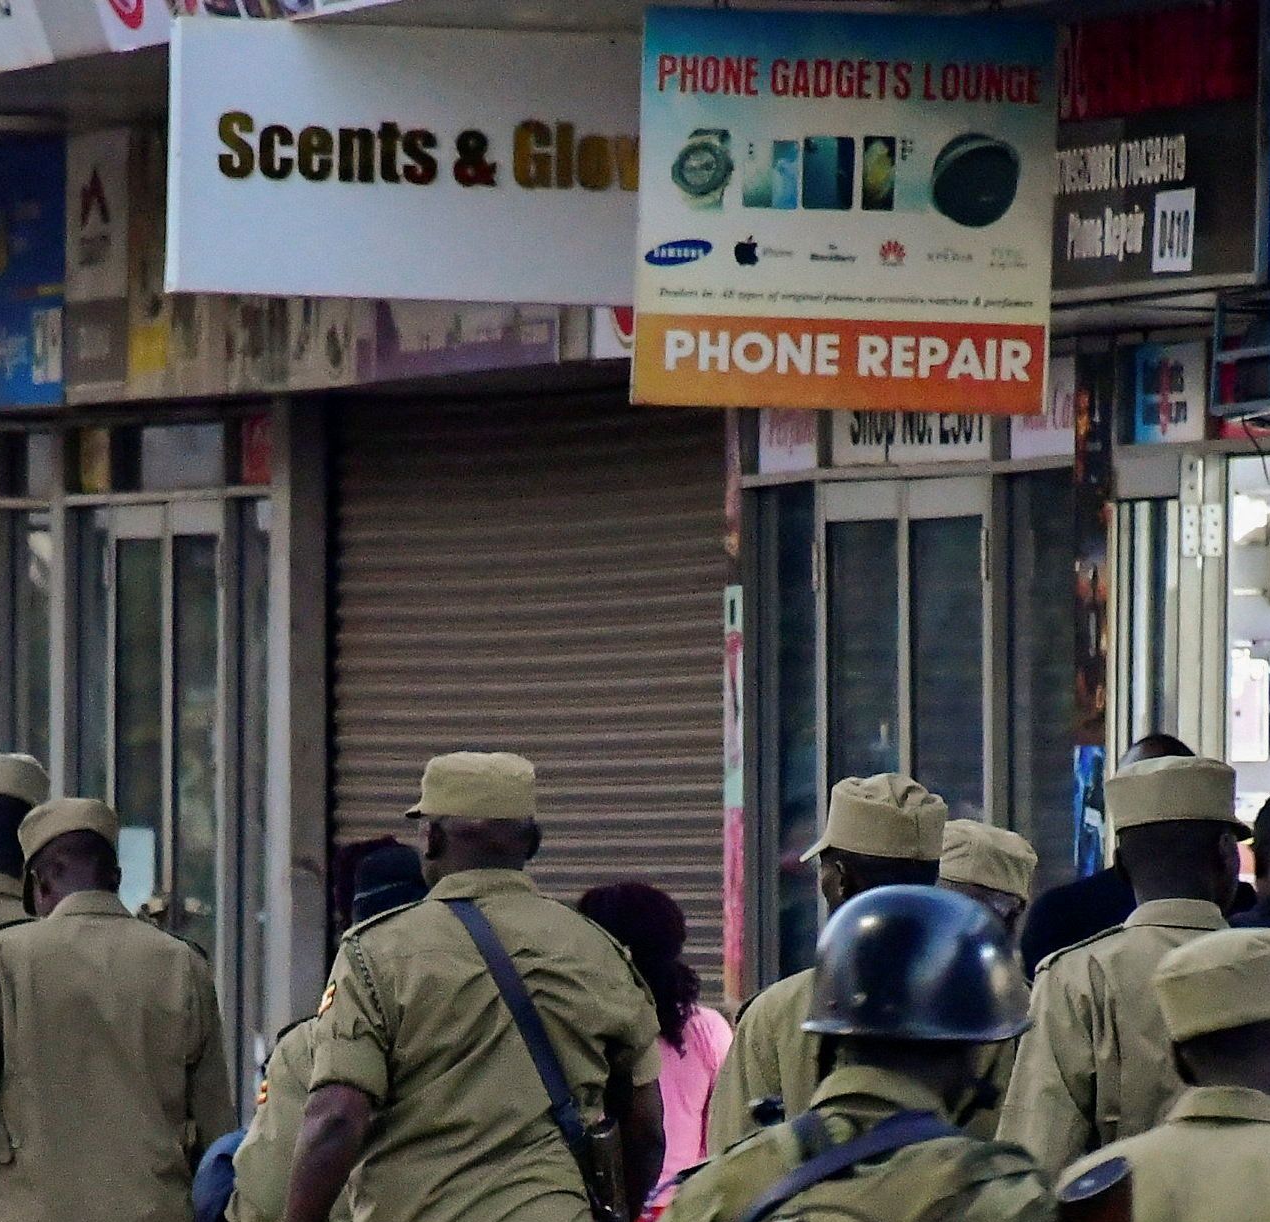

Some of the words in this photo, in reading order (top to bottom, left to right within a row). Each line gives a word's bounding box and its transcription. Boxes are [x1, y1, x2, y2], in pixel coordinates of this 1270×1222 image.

[658, 54, 760, 97] PHONE
[770, 57, 913, 101] GADGETS
[924, 63, 1044, 106] LOUNGE
[218, 111, 439, 186] Scents
[453, 128, 498, 188] &
[664, 329, 840, 376] PHONE
[857, 335, 1033, 383] REPAIR
